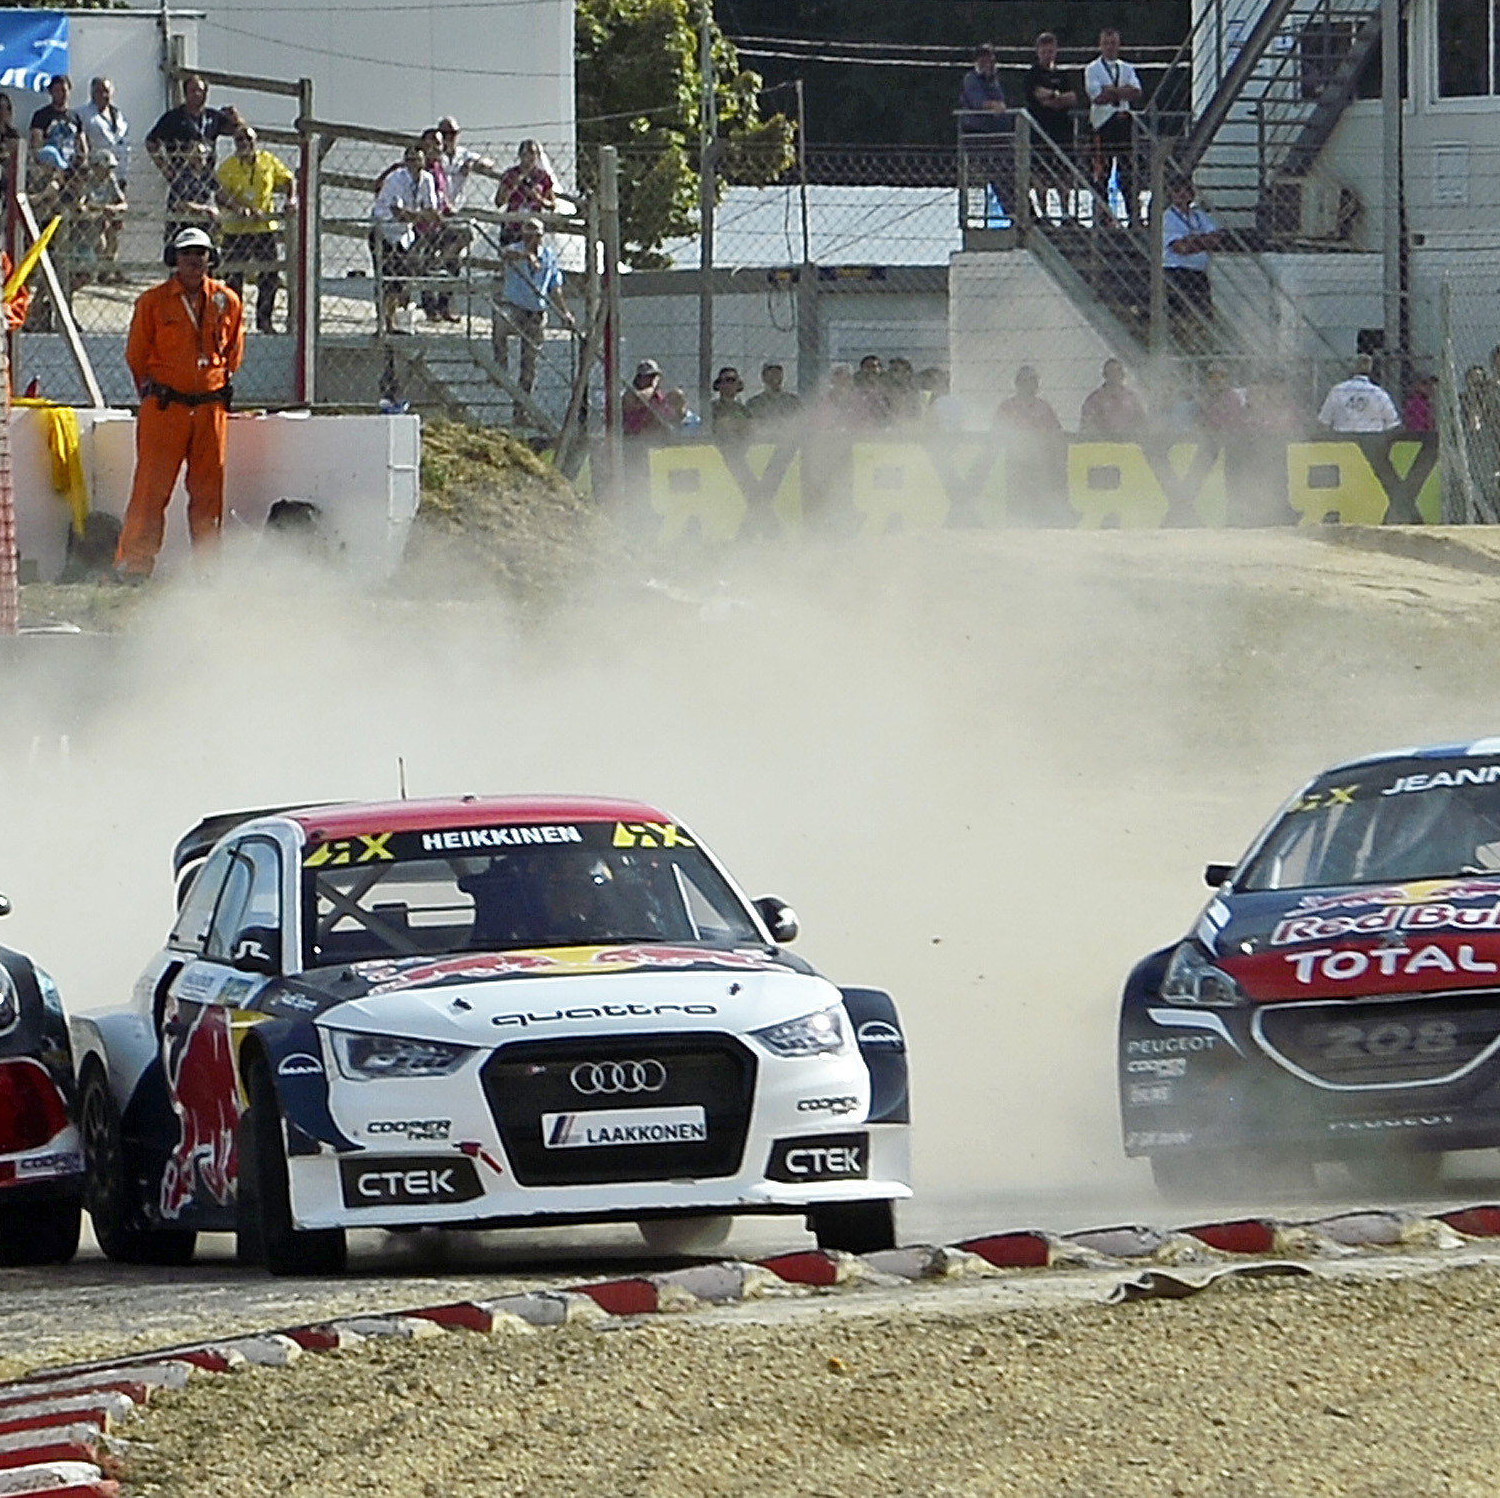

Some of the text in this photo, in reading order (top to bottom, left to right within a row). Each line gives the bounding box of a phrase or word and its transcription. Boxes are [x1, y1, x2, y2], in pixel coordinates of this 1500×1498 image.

[421, 826, 583, 851] HEIKKINEN
[1271, 905, 1401, 945] Red
[1284, 945, 1498, 984] TOTAL
[491, 1003, 718, 1027] quattro
[1127, 1036, 1217, 1053] PEUGEOT
[1321, 1020, 1459, 1059] 208
[366, 1119, 452, 1134] COOPER
[585, 1122, 706, 1144] LAAKKONEN
[785, 1147, 862, 1174] CTEK
[357, 1168, 455, 1197] CTEK
